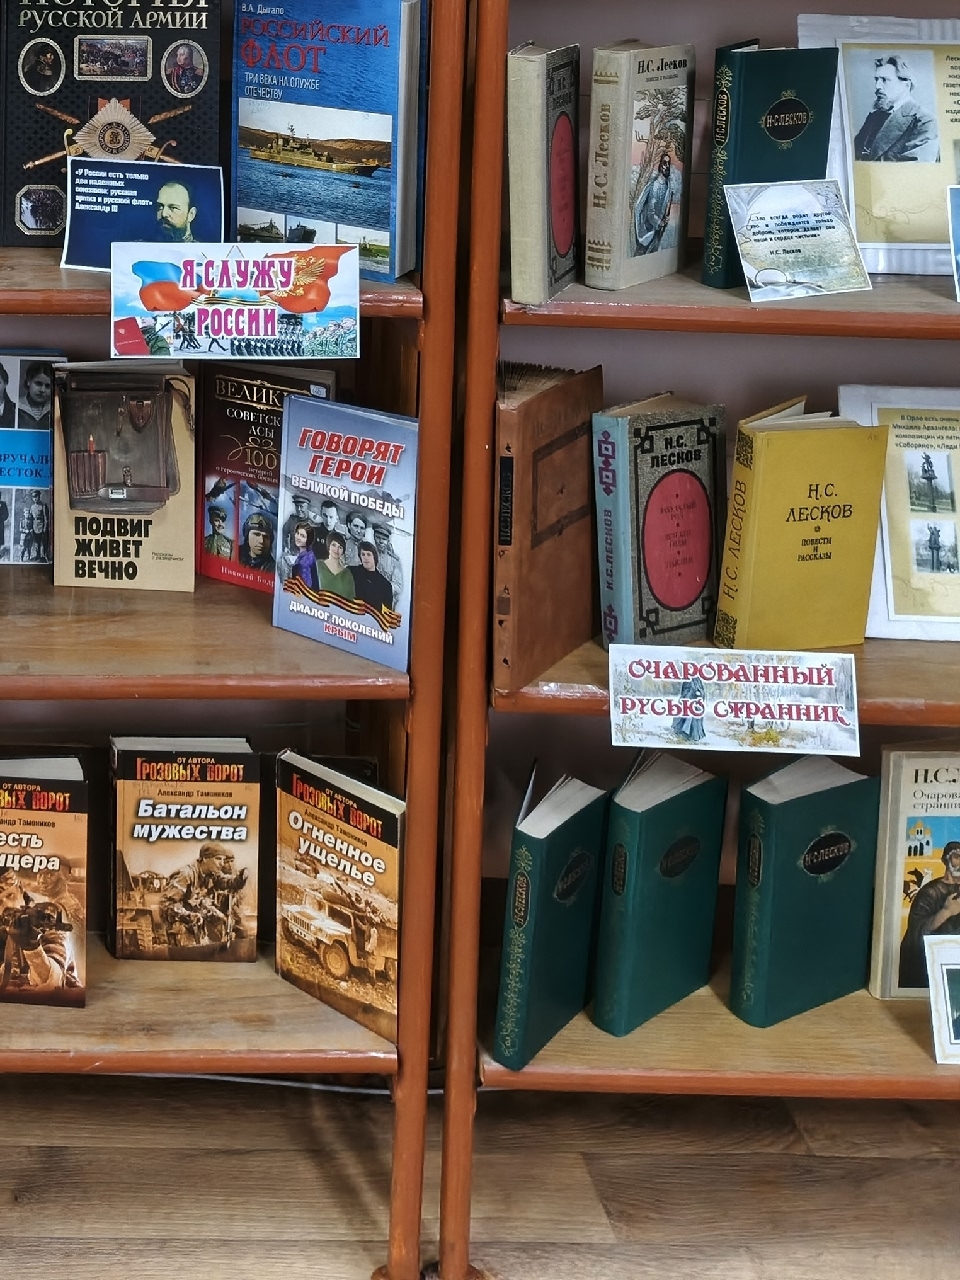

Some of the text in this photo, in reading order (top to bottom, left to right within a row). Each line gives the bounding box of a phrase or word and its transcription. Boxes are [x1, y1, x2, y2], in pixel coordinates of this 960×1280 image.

[18, 7, 209, 33] РУССКОЙ АРМИИ
[241, 18, 390, 49] РОССИЙСКИЙ
[241, 39, 327, 73] ФЛОТ
[245, 72, 320, 90] ТРИ ВЕКА НА СЛУЖБЕ
[244, 86, 283, 100] ОТЕЧЕСТВУ
[180, 260, 293, 289] Я СЛУЖУ
[196, 308, 278, 337] РОССИИ
[248, 425, 274, 439] АСЫ
[298, 427, 405, 466] ГОВОРЯТ
[245, 447, 278, 470] 100
[307, 452, 387, 487] ГЕРОИ
[650, 449, 702, 468] ЛЕСКОВ
[291, 474, 405, 519] ВЕЛИКОЙ ПОБЕДЫ
[785, 504, 854, 524] ЛЕСКОВ
[74, 516, 153, 538] ПОДВИГ
[74, 537, 143, 558] ЖИВЕТ
[801, 536, 832, 548] ПОВЕСТИ
[797, 552, 833, 562] РАССКАЗЫ
[74, 558, 138, 581] ВЕЧНО
[289, 599, 394, 645] ДИАЛОГ ПОКОЛЕНИЙ
[323, 622, 358, 643] КРЫМ
[628, 657, 835, 687] ОЧАРОВАННЫЙ
[619, 696, 851, 727] РУСЬЮ СТРАННИК
[137, 799, 248, 821] Батальон
[132, 823, 248, 845] мужества
[287, 809, 387, 875] Огненное
[297, 838, 377, 888] ущелье
